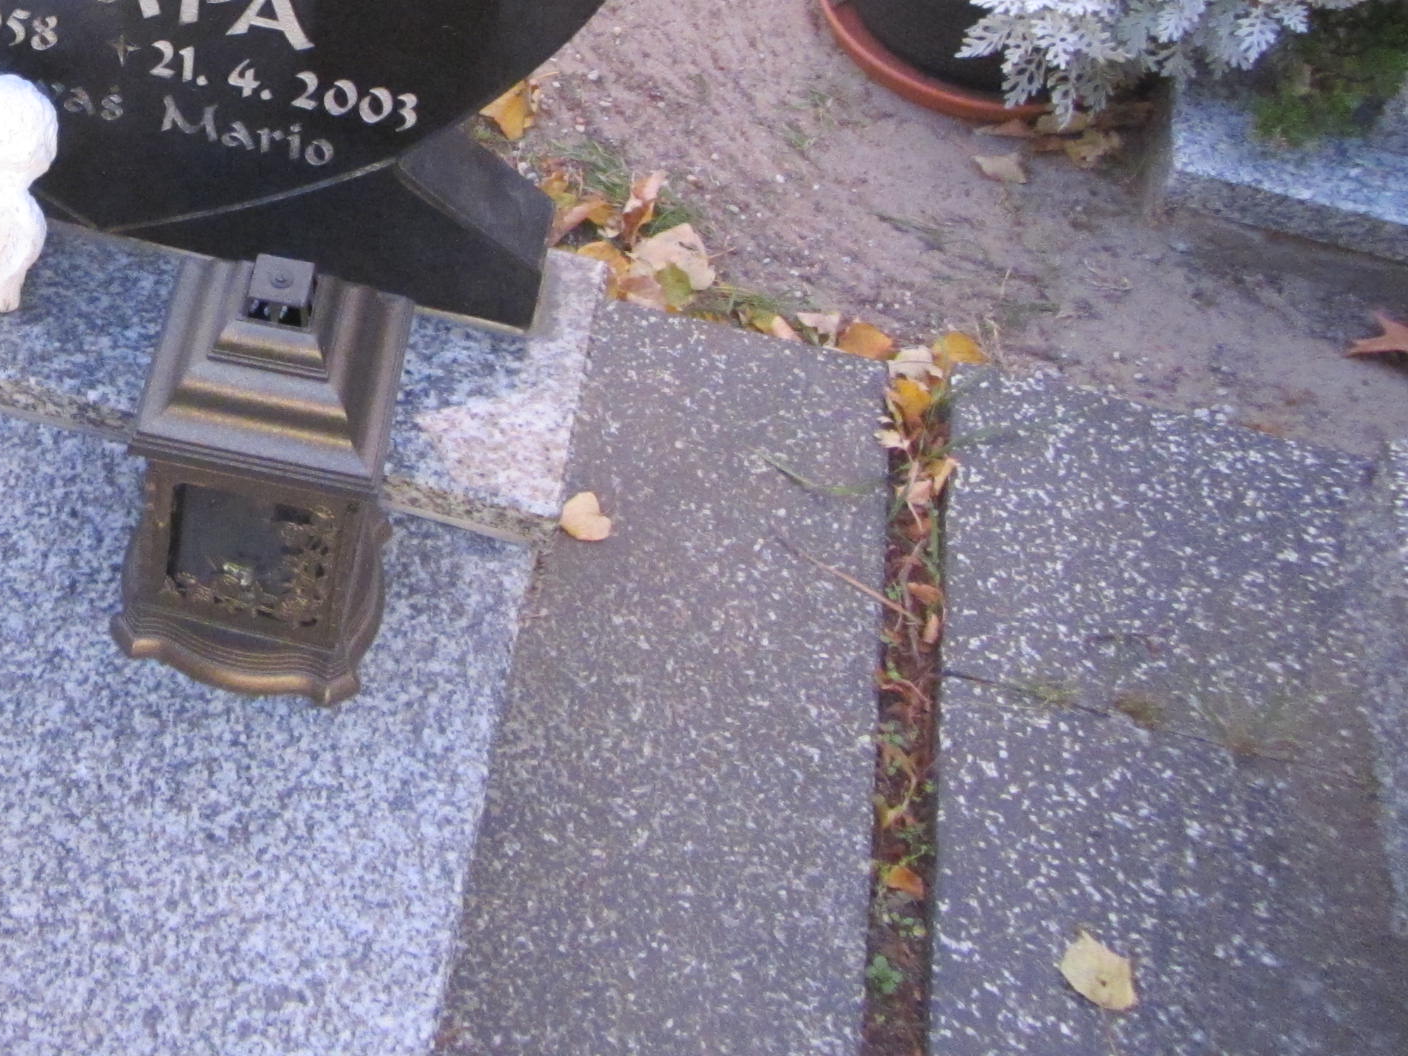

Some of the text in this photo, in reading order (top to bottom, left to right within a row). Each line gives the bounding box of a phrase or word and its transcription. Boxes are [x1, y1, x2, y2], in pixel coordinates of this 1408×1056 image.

[148, 38, 209, 88] 21.
[227, 57, 273, 101] 4.
[291, 70, 419, 132] 2003
[160, 94, 336, 166] Mario
